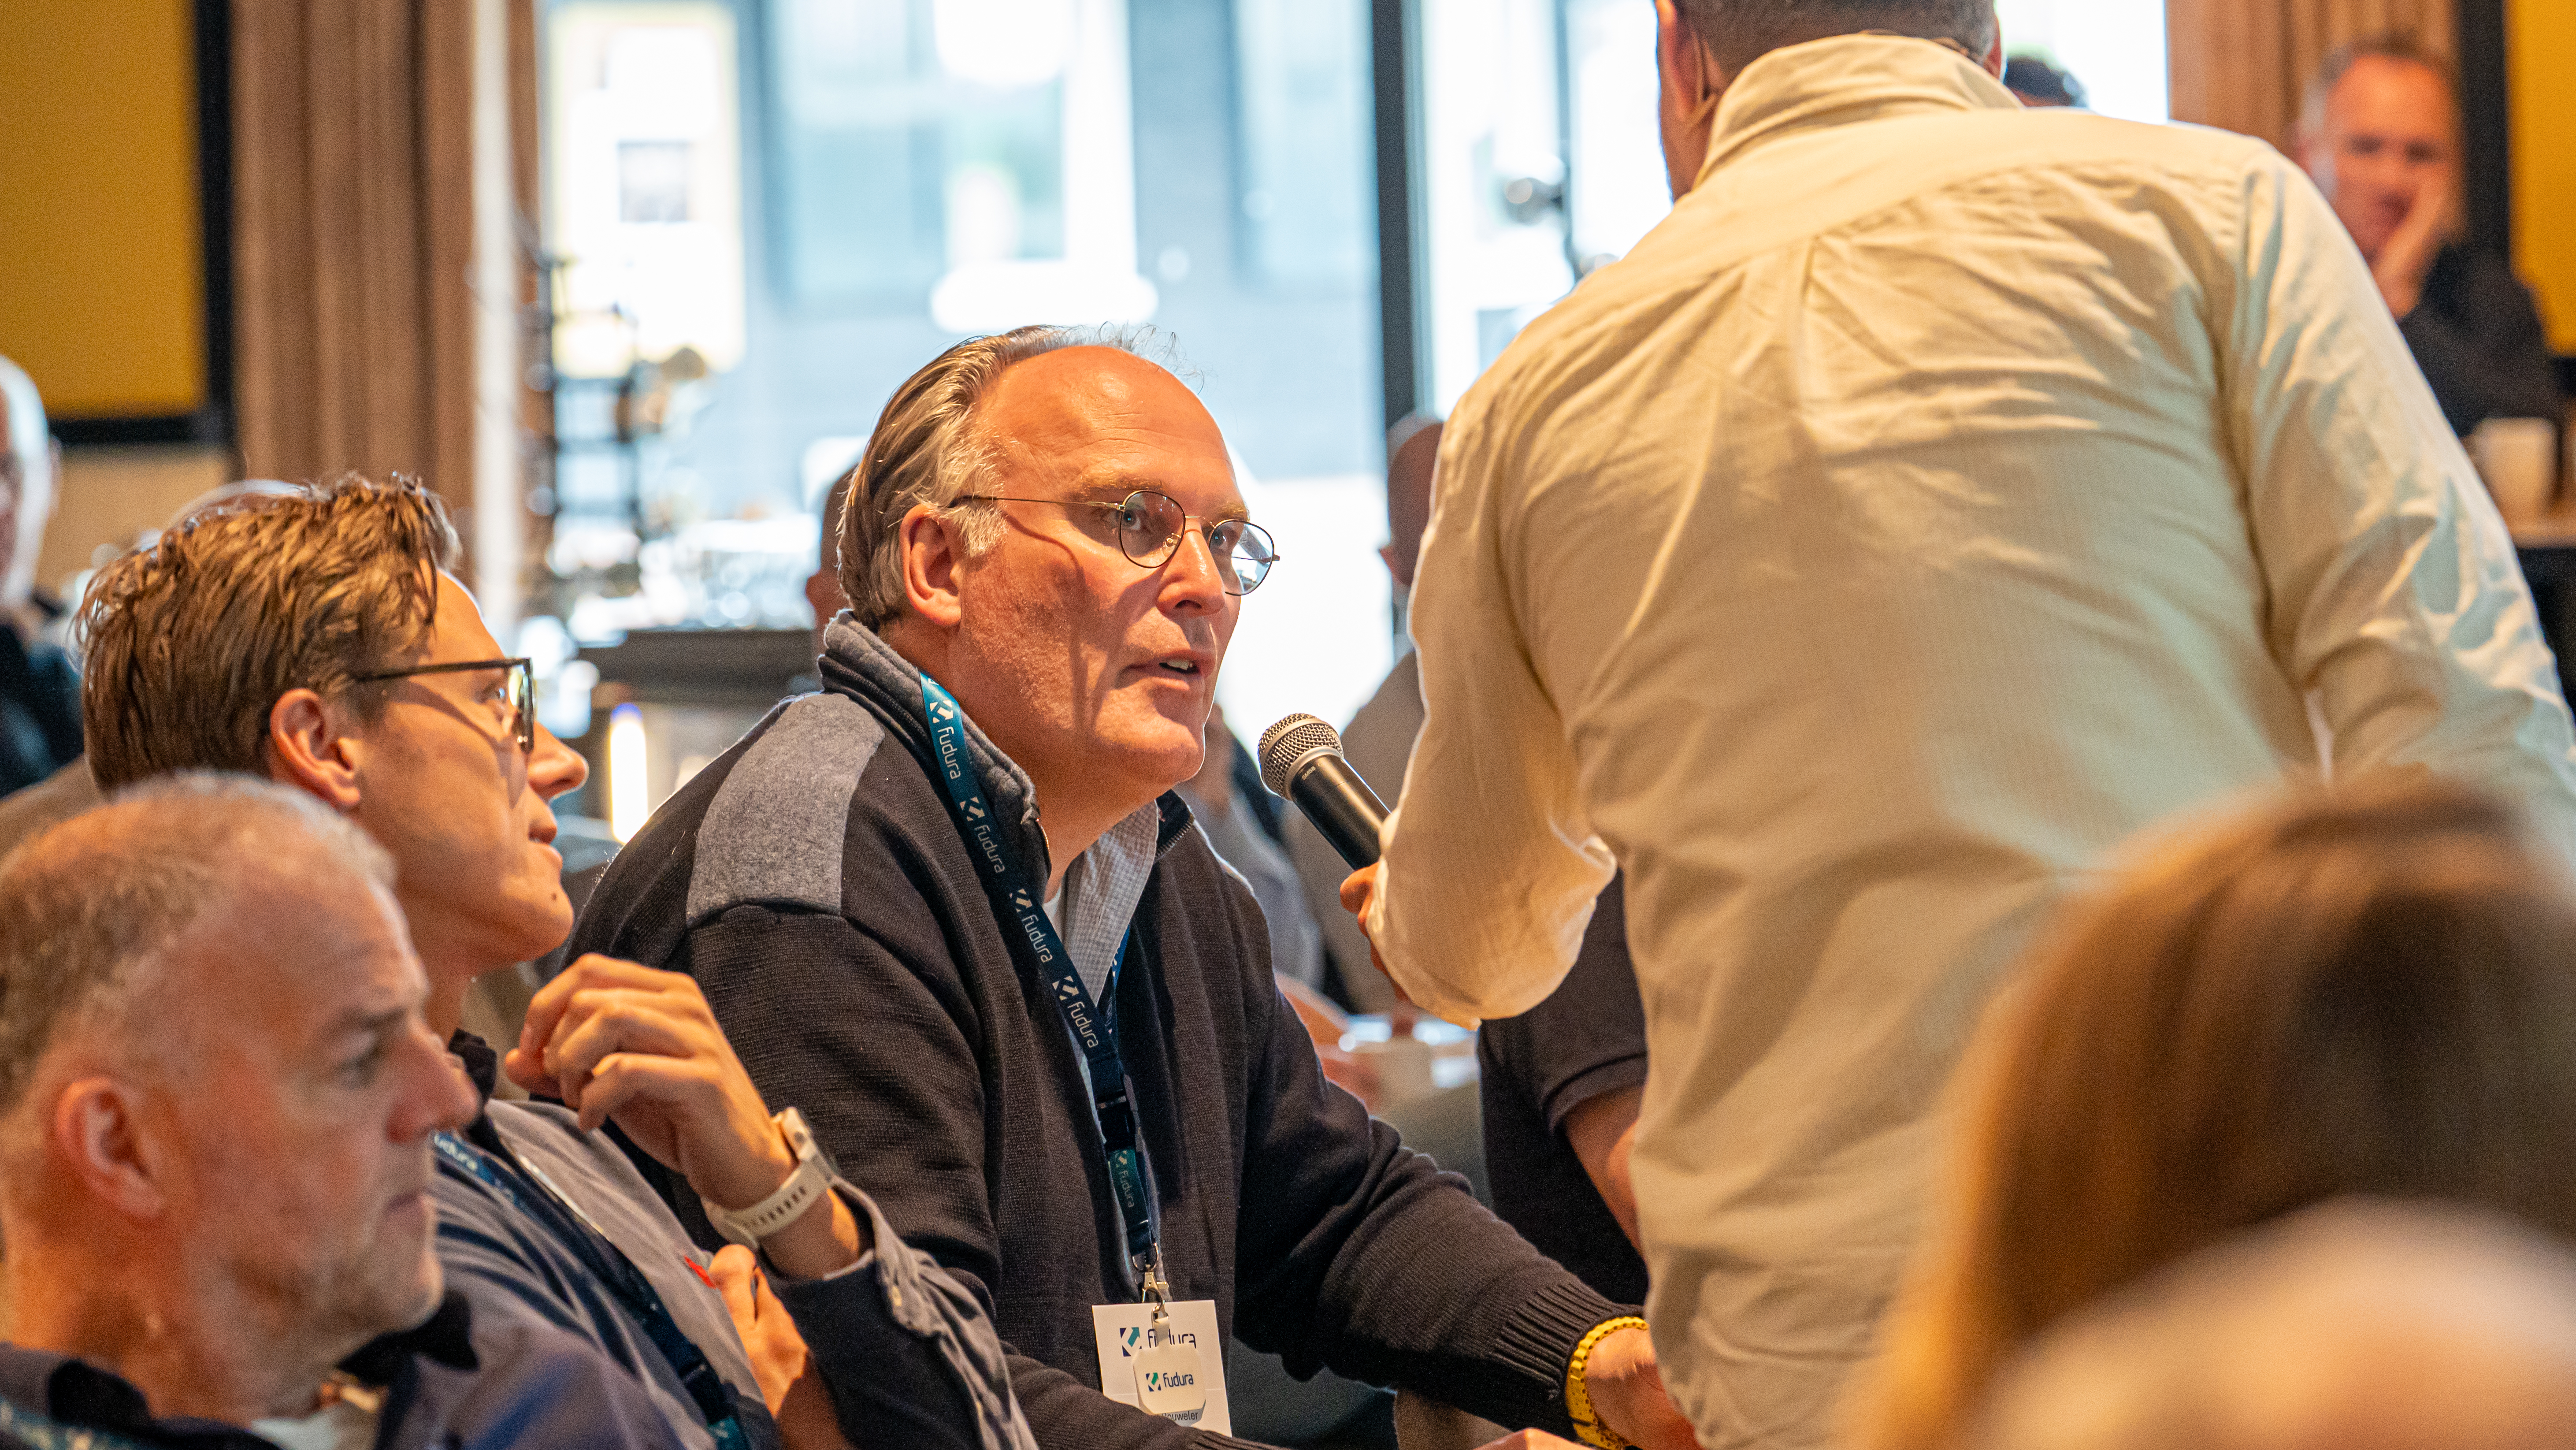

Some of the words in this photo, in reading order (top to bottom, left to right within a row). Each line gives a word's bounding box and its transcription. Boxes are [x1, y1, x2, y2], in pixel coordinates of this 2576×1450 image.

[937, 726, 961, 780] fudura
[974, 824, 1005, 873] fudura
[1022, 915, 1053, 963] fudura
[1068, 1001, 1099, 1048] fudura
[1119, 1170, 1134, 1208] fudura
[1163, 1372, 1194, 1388] fudura
[1162, 1411, 1198, 1420] ouweler
